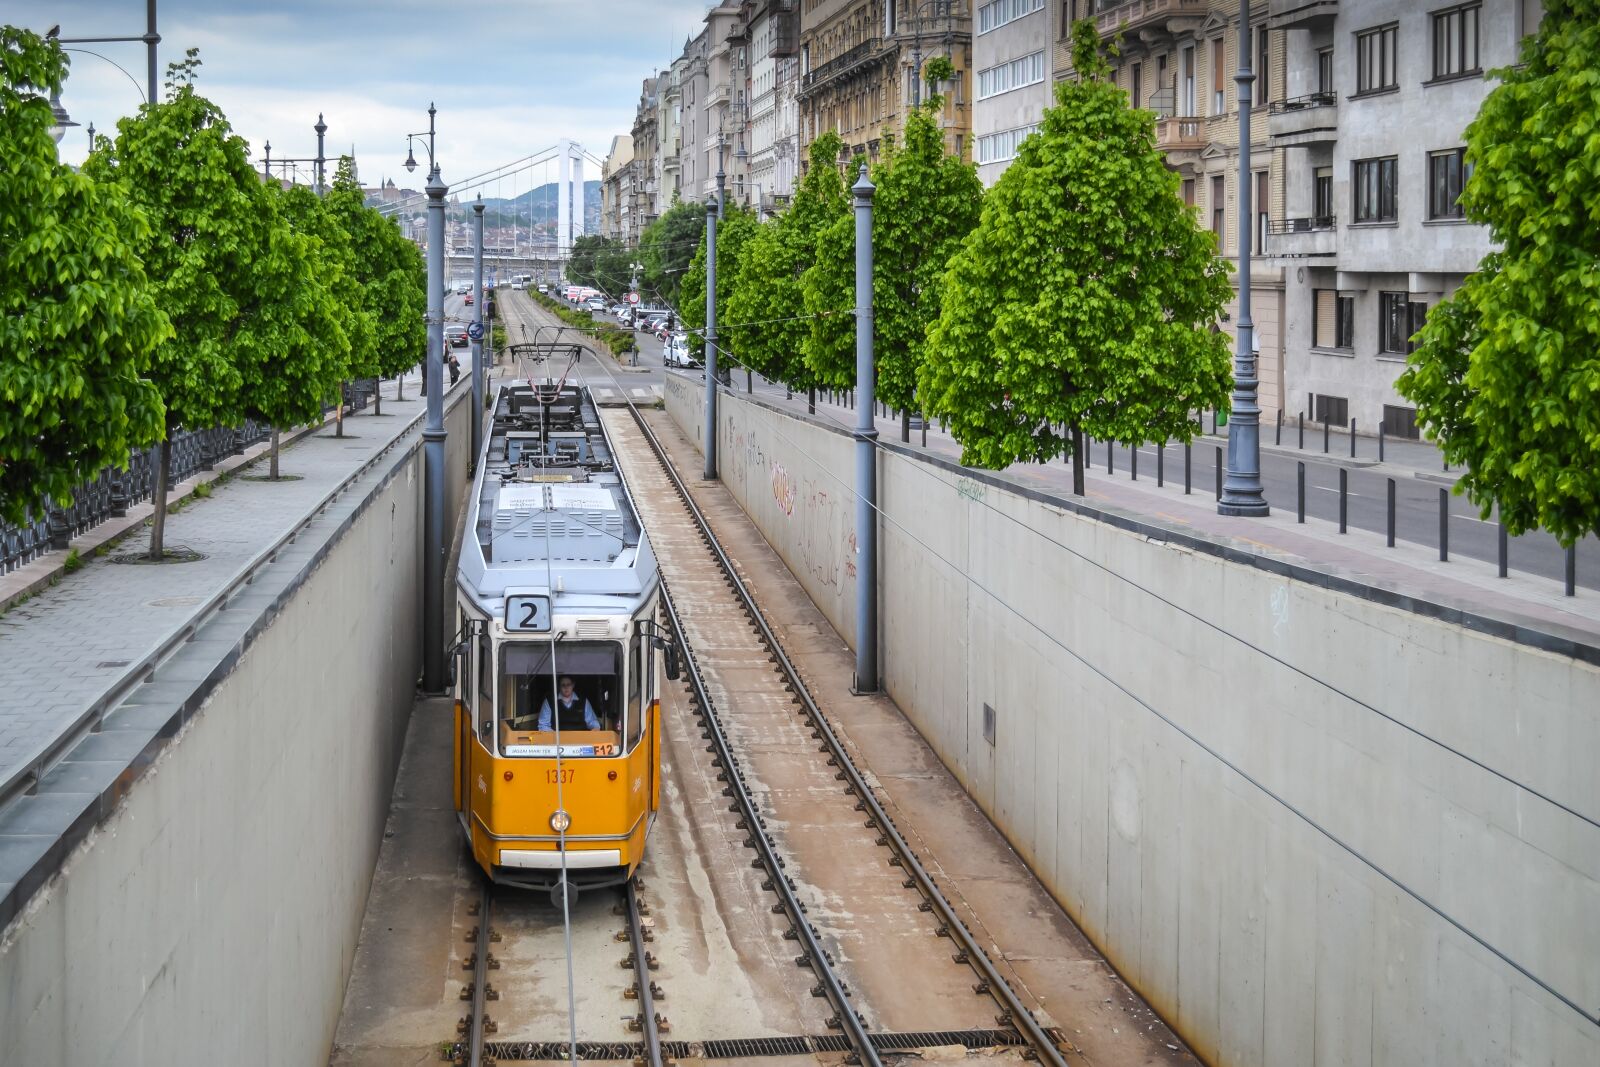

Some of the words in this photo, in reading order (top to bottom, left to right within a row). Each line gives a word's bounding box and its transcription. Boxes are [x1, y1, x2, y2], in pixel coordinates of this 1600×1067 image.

[519, 602, 538, 628] 2
[593, 744, 614, 755] F12
[546, 769, 574, 784] 1337
